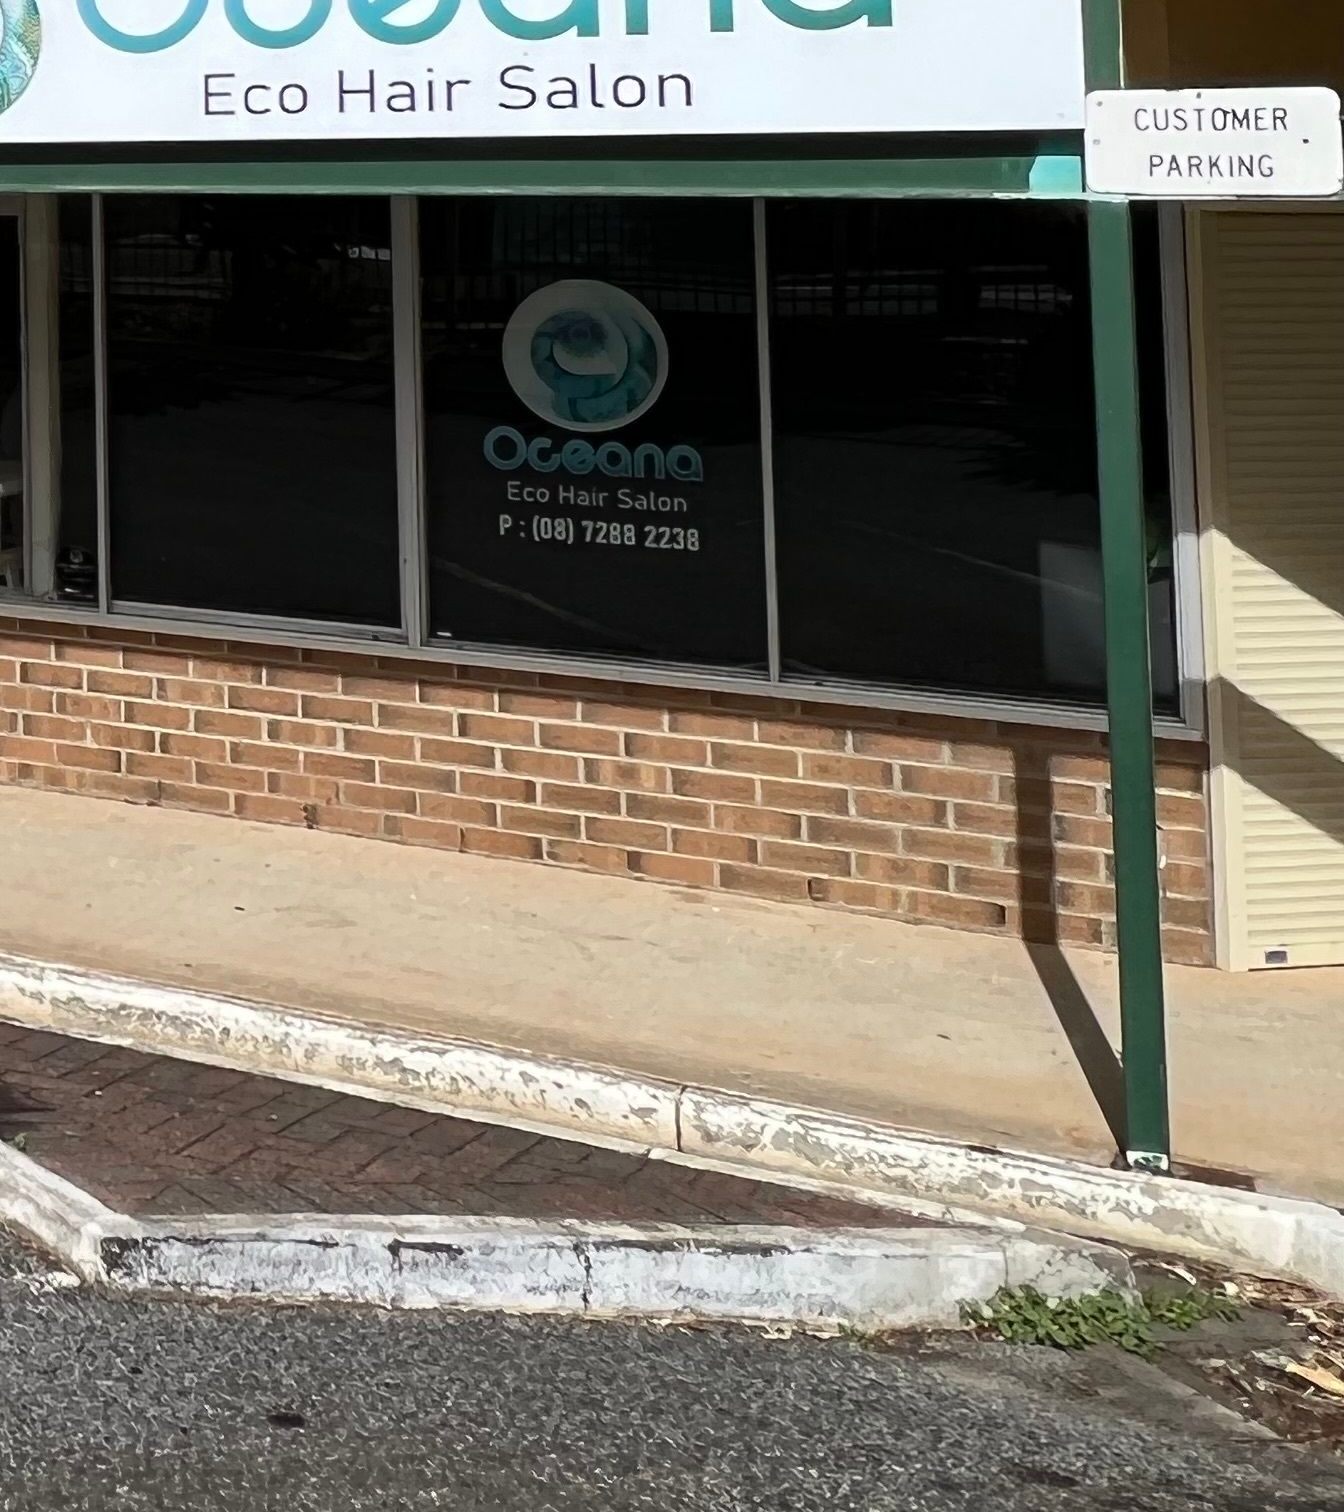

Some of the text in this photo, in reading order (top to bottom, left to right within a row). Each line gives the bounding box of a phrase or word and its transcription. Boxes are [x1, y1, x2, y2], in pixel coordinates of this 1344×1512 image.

[203, 61, 694, 117] Eco Hair Salon
[1132, 106, 1289, 133] CUSTOMER
[1147, 153, 1276, 181] PARKING
[483, 425, 703, 481] Oceana
[506, 481, 688, 512] Eco Hair Salon
[644, 525, 700, 552] 2238
